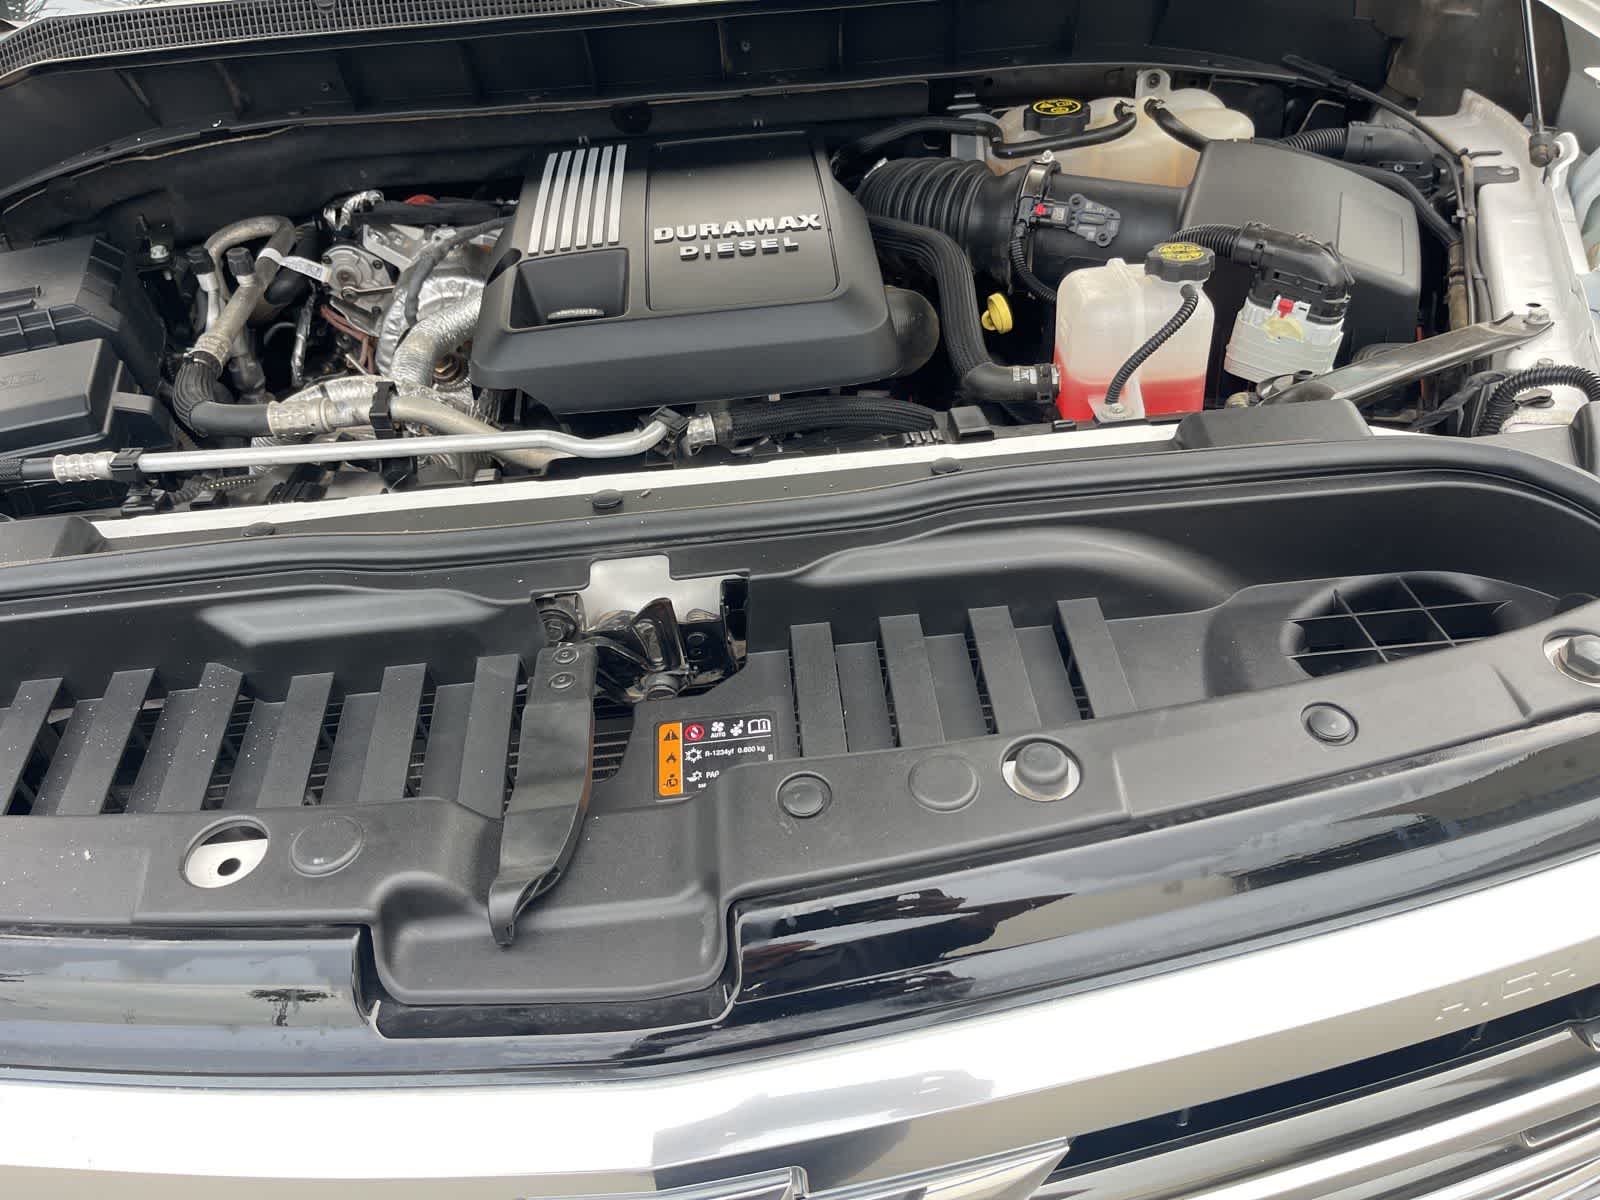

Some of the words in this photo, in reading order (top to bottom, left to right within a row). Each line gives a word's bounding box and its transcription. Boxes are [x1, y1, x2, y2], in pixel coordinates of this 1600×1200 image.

[653, 214, 822, 243] DURAMAX
[679, 237, 799, 261] DIESEL
[710, 731, 726, 739] AUTO
[756, 744, 766, 753] kg
